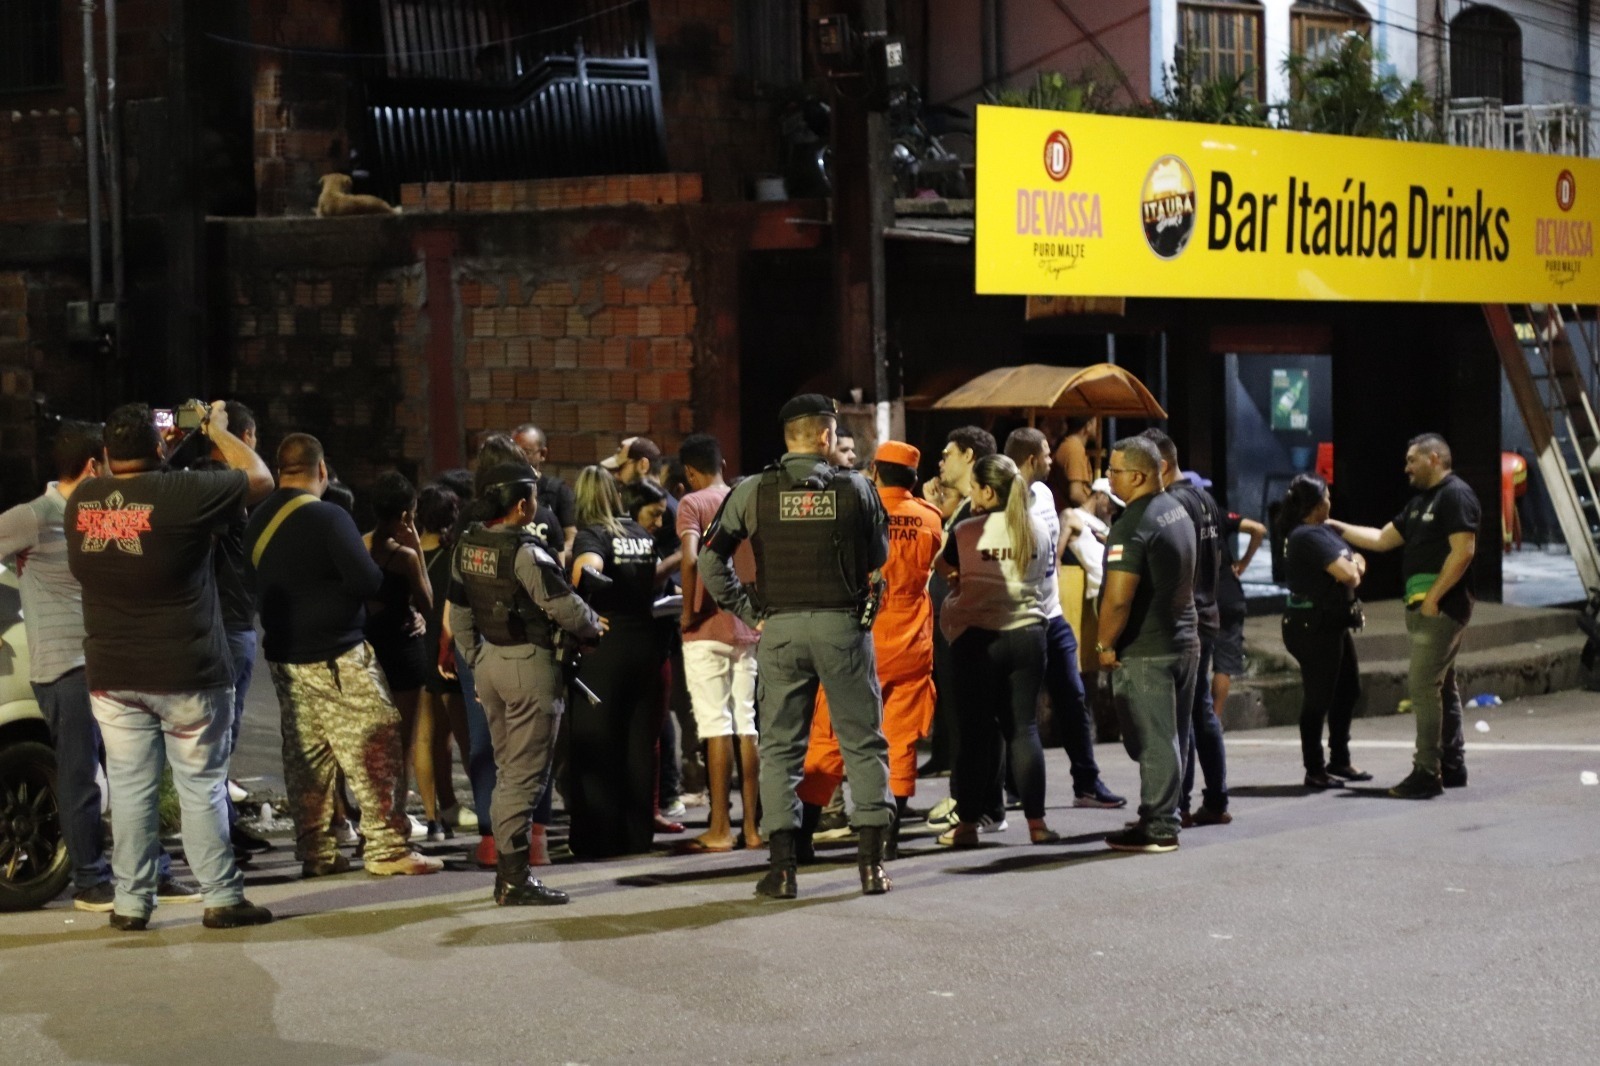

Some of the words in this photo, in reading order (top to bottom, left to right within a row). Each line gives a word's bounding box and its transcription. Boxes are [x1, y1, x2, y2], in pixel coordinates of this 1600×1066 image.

[1017, 189, 1103, 238] DEVASSA
[1207, 170, 1278, 253] Bar
[1285, 176, 1398, 259] Itaúba
[1406, 184, 1510, 263] Drinks
[1536, 219, 1593, 256] DEVASSA
[1033, 242, 1056, 257] PURO
[1058, 243, 1086, 259] MALTE
[782, 494, 832, 507] FORÇA
[782, 505, 834, 517] TÁTICA
[522, 522, 548, 540] SC
[463, 547, 496, 563] FORÇA
